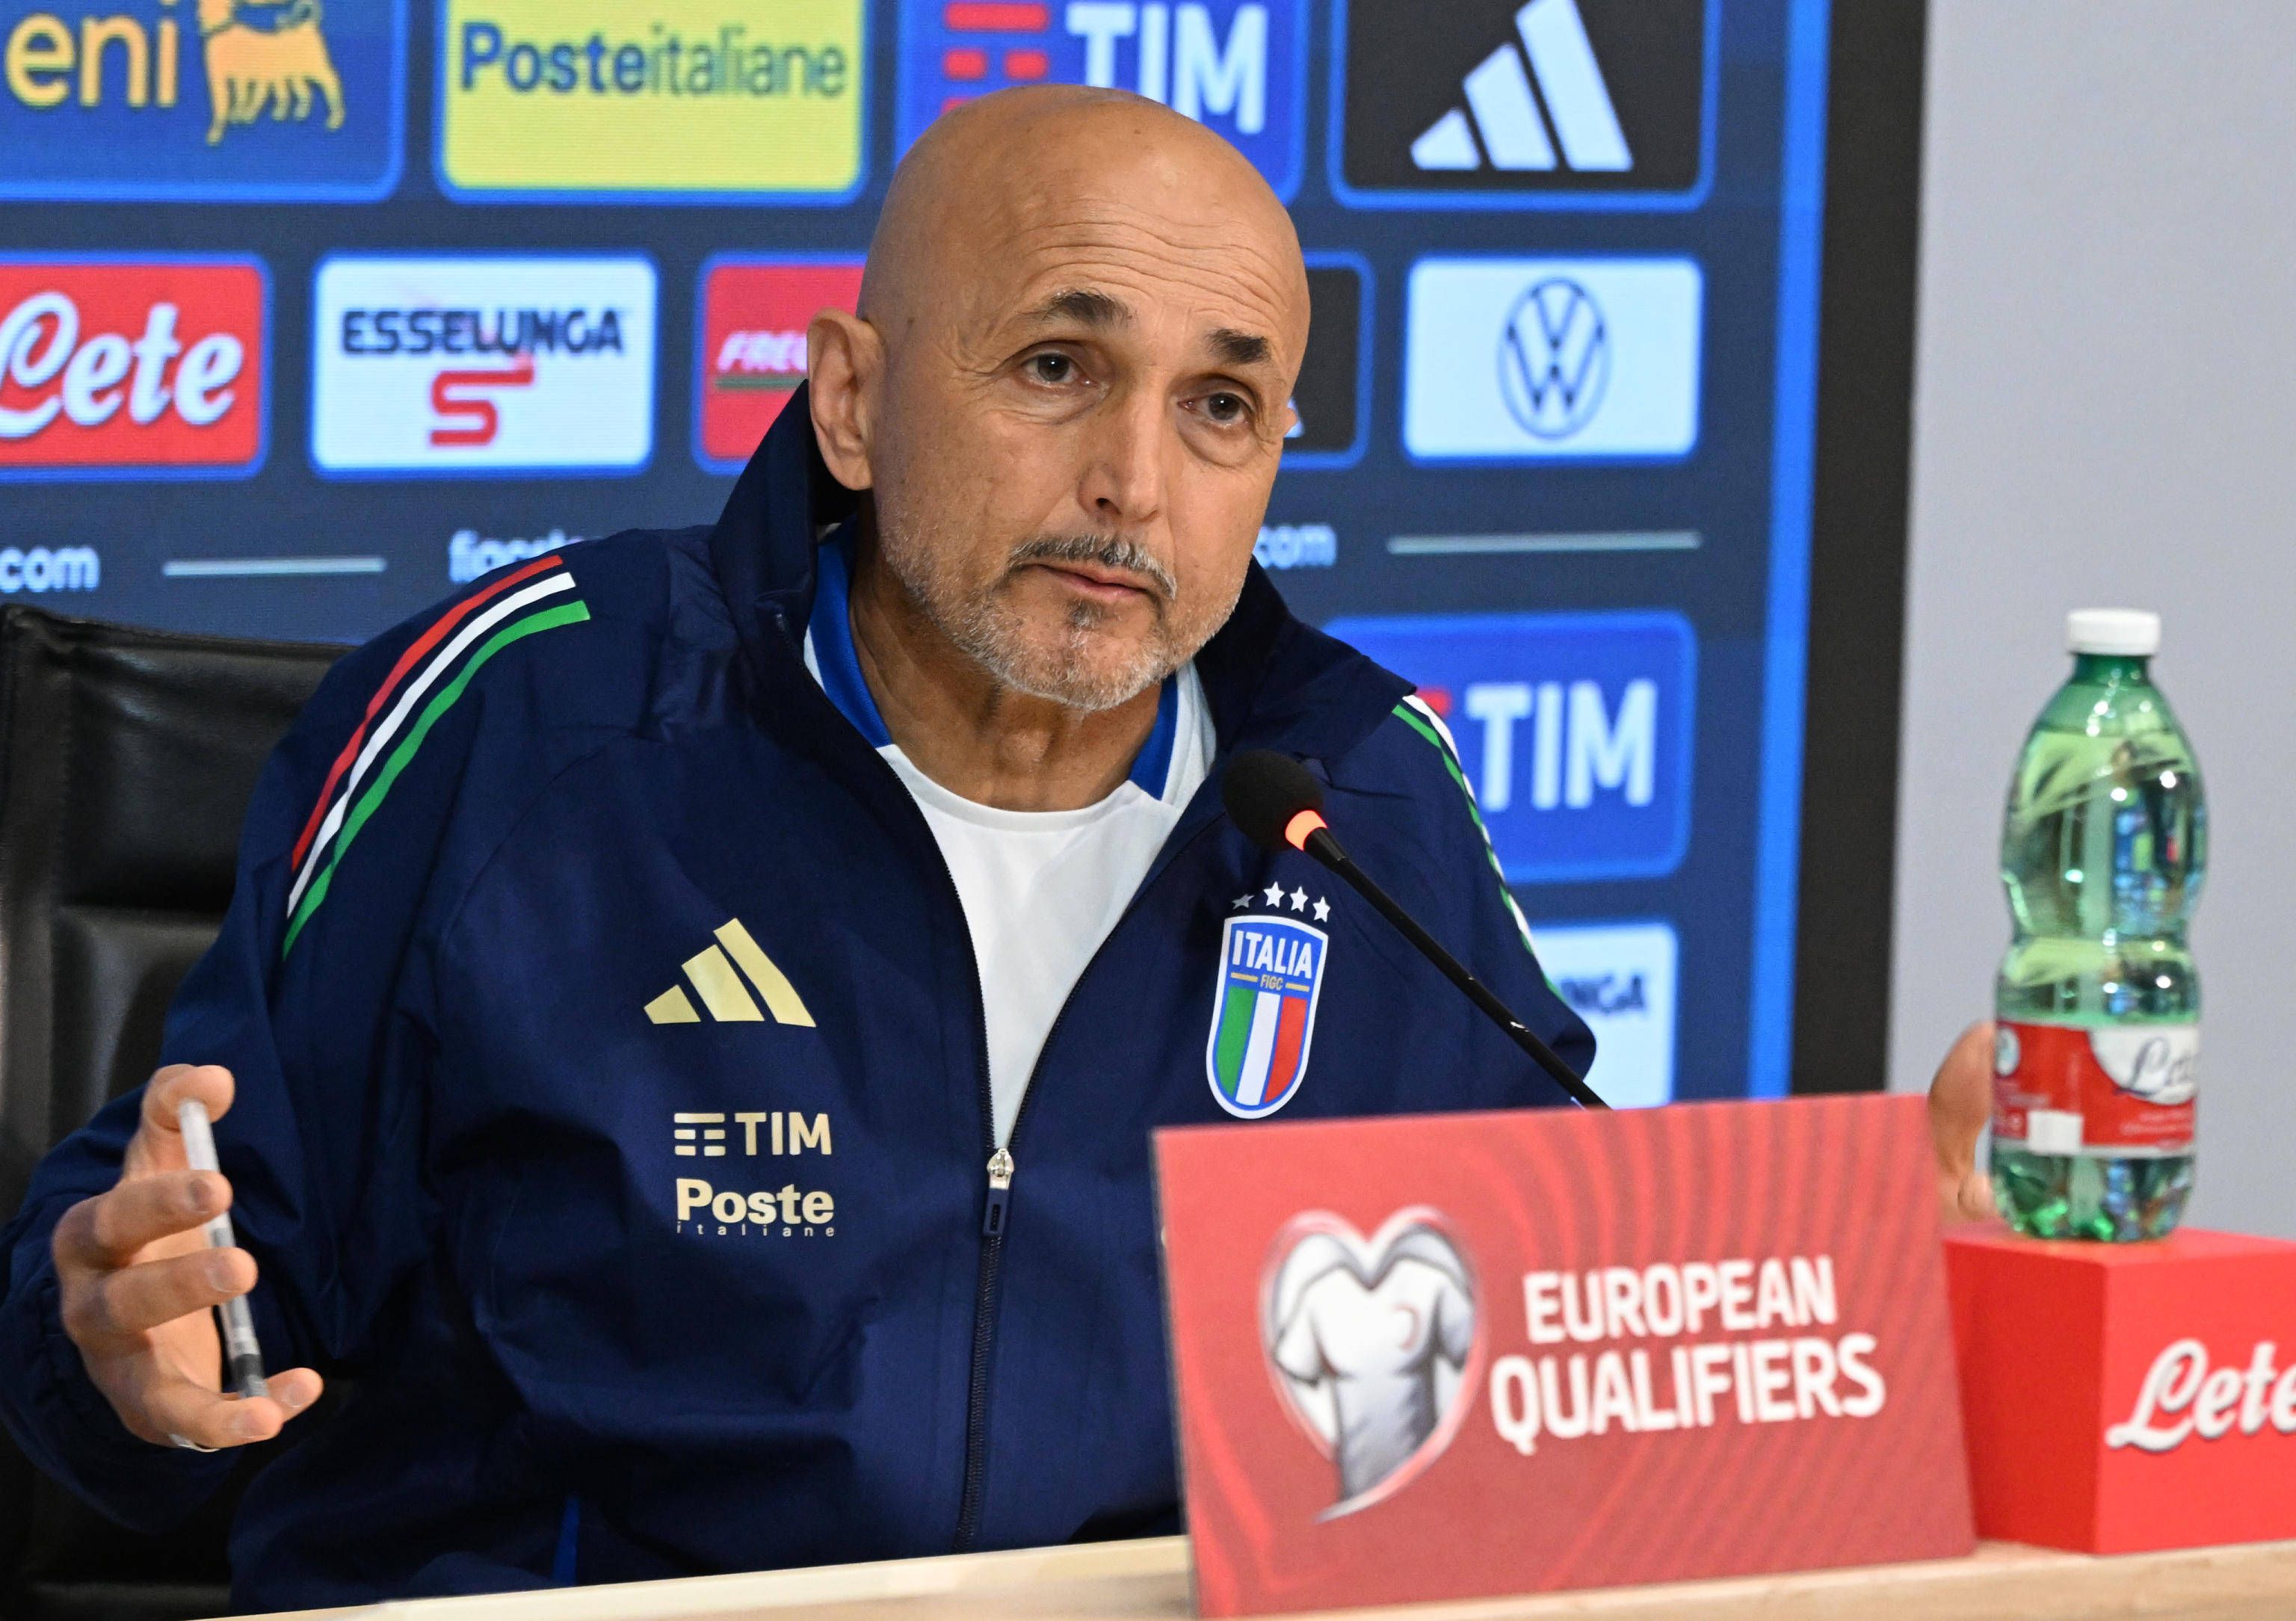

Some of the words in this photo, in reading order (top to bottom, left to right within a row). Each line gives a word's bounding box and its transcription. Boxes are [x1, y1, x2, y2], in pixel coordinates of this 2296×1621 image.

[5, 13, 179, 109] eni
[1065, 2, 1269, 135] TIM
[0, 291, 244, 439] Lete
[342, 308, 623, 356] ESSELUNGA
[1464, 679, 1658, 812] TIM
[1232, 930, 1312, 979] ITALIA
[1259, 973, 1284, 991] FIGC
[734, 1111, 833, 1156] TIM
[676, 1177, 835, 1225] Poste
[676, 1221, 835, 1238] italiane
[1522, 1256, 1839, 1344] EUROPEAN
[1490, 1333, 1886, 1456] QUALIFIERS
